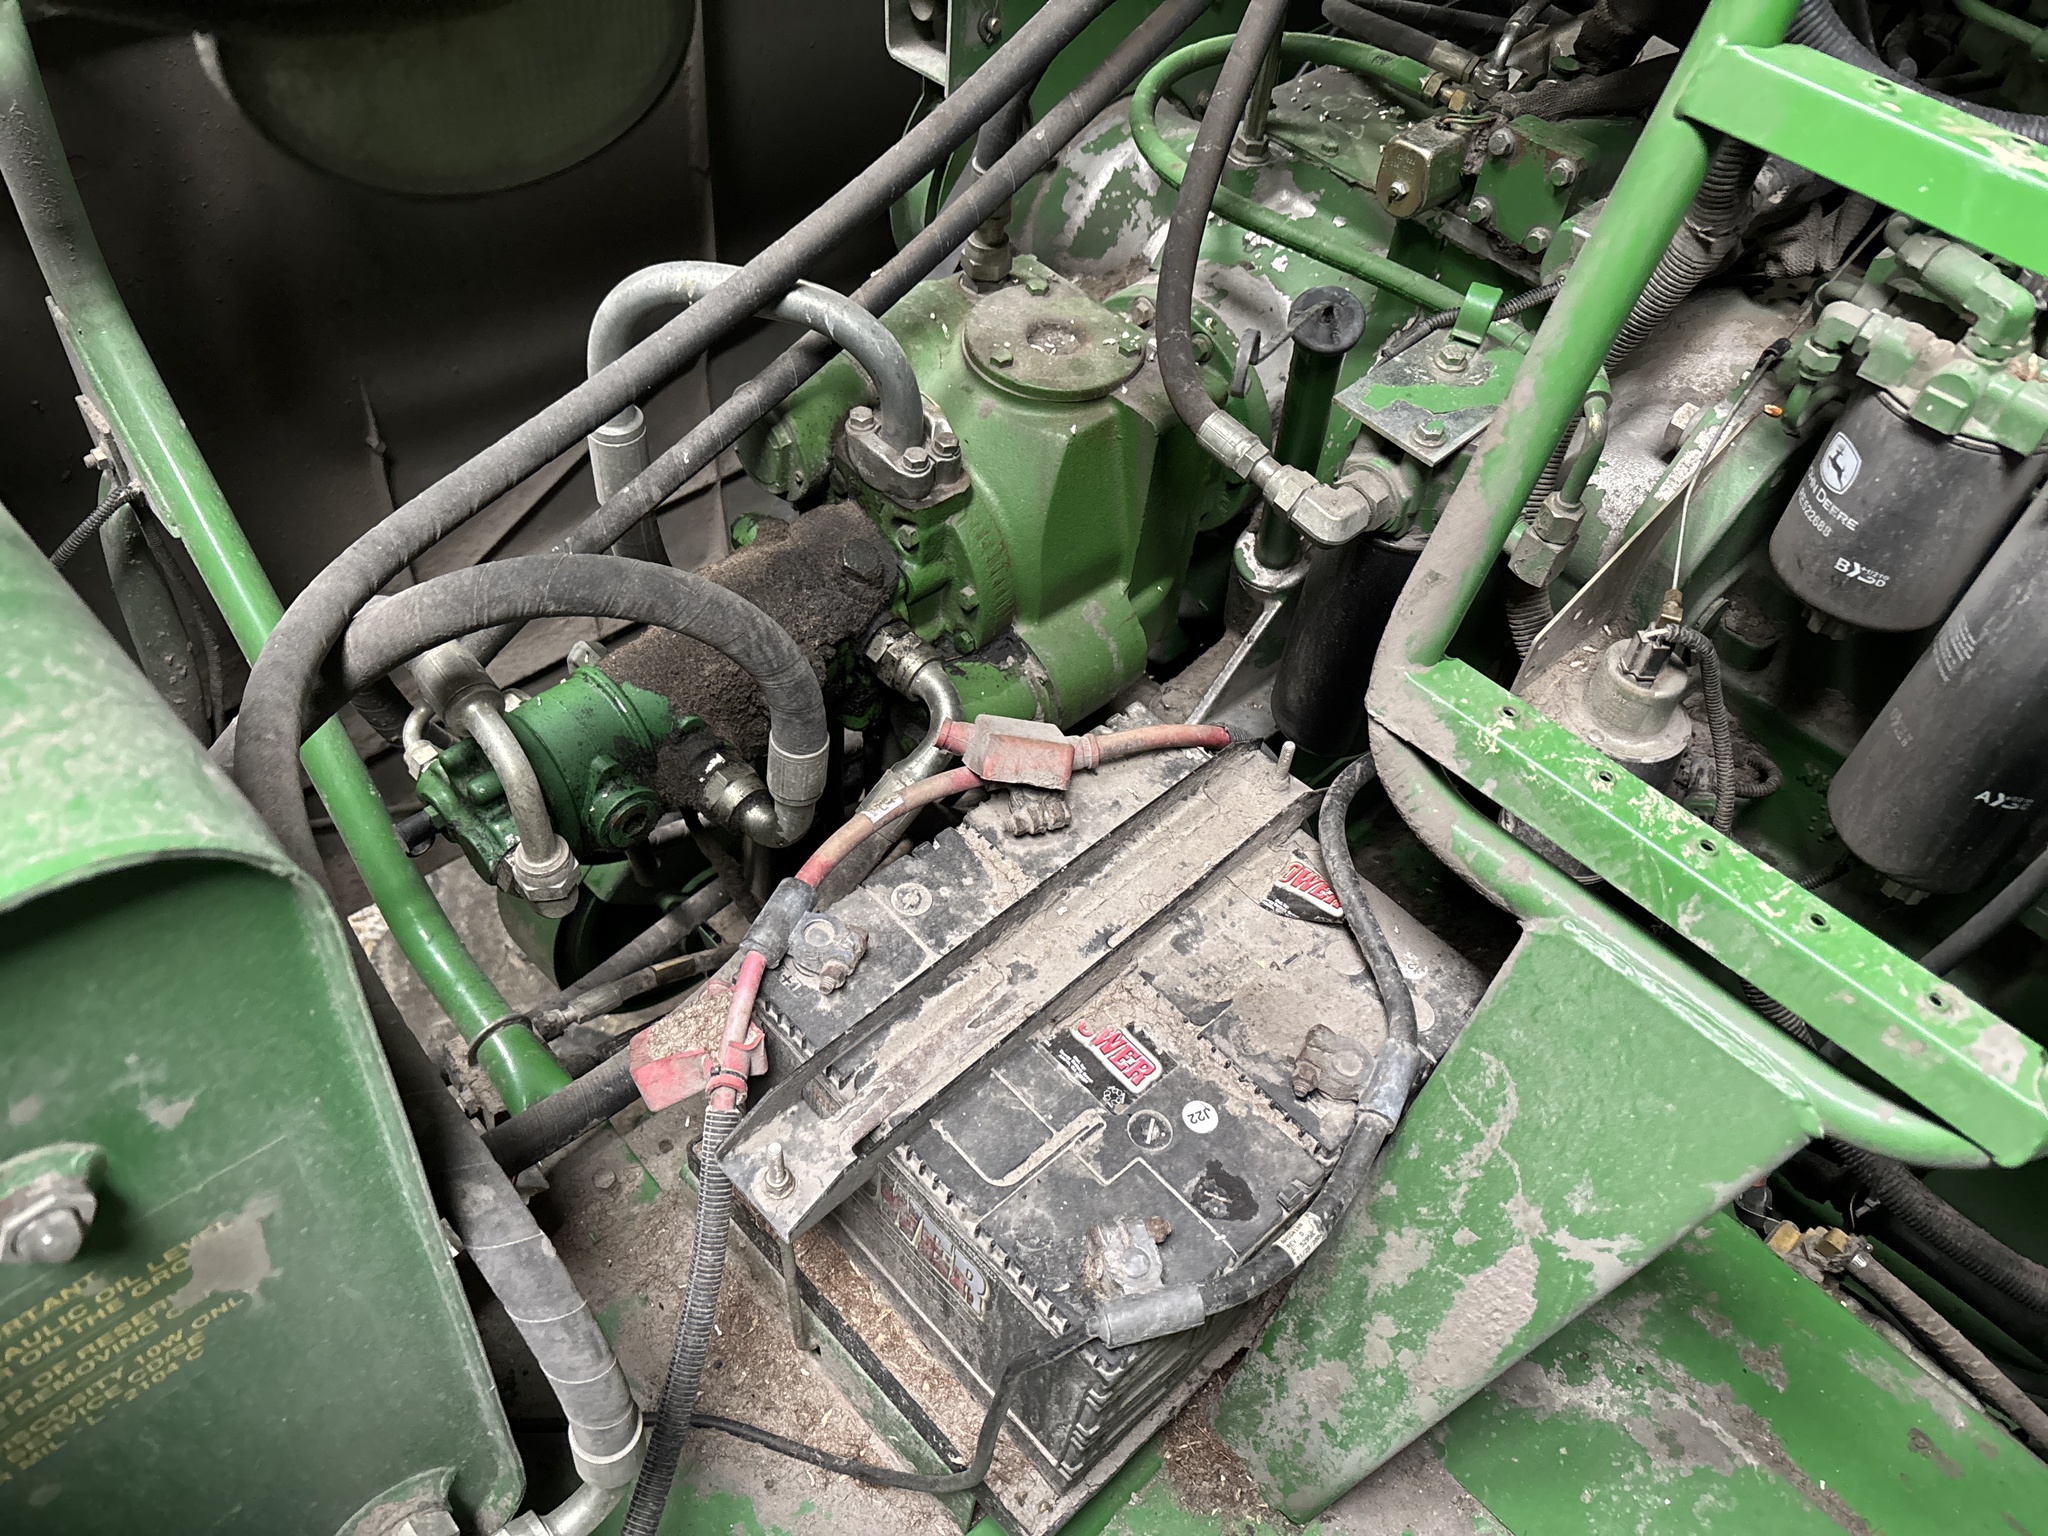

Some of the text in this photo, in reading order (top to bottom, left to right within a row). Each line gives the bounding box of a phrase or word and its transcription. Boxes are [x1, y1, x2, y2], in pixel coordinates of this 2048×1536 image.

[1815, 487, 1860, 531] DEERE
[1187, 1107, 1210, 1124] J22
[0, 1271, 94, 1339] RTANT
[0, 1304, 87, 1365] AULIC
[95, 1276, 142, 1304] OIL
[20, 1335, 63, 1366] ON
[67, 1298, 125, 1334] THE
[131, 1258, 189, 1298] GRO
[32, 1360, 69, 1387] OF
[76, 1299, 167, 1360] RESER
[2, 1366, 123, 1450] ISCOSITY
[135, 1328, 183, 1365] 10W
[191, 1298, 244, 1329] ONL
[15, 1320, 160, 1416] REMOVING
[7, 1384, 123, 1464] SERVICE
